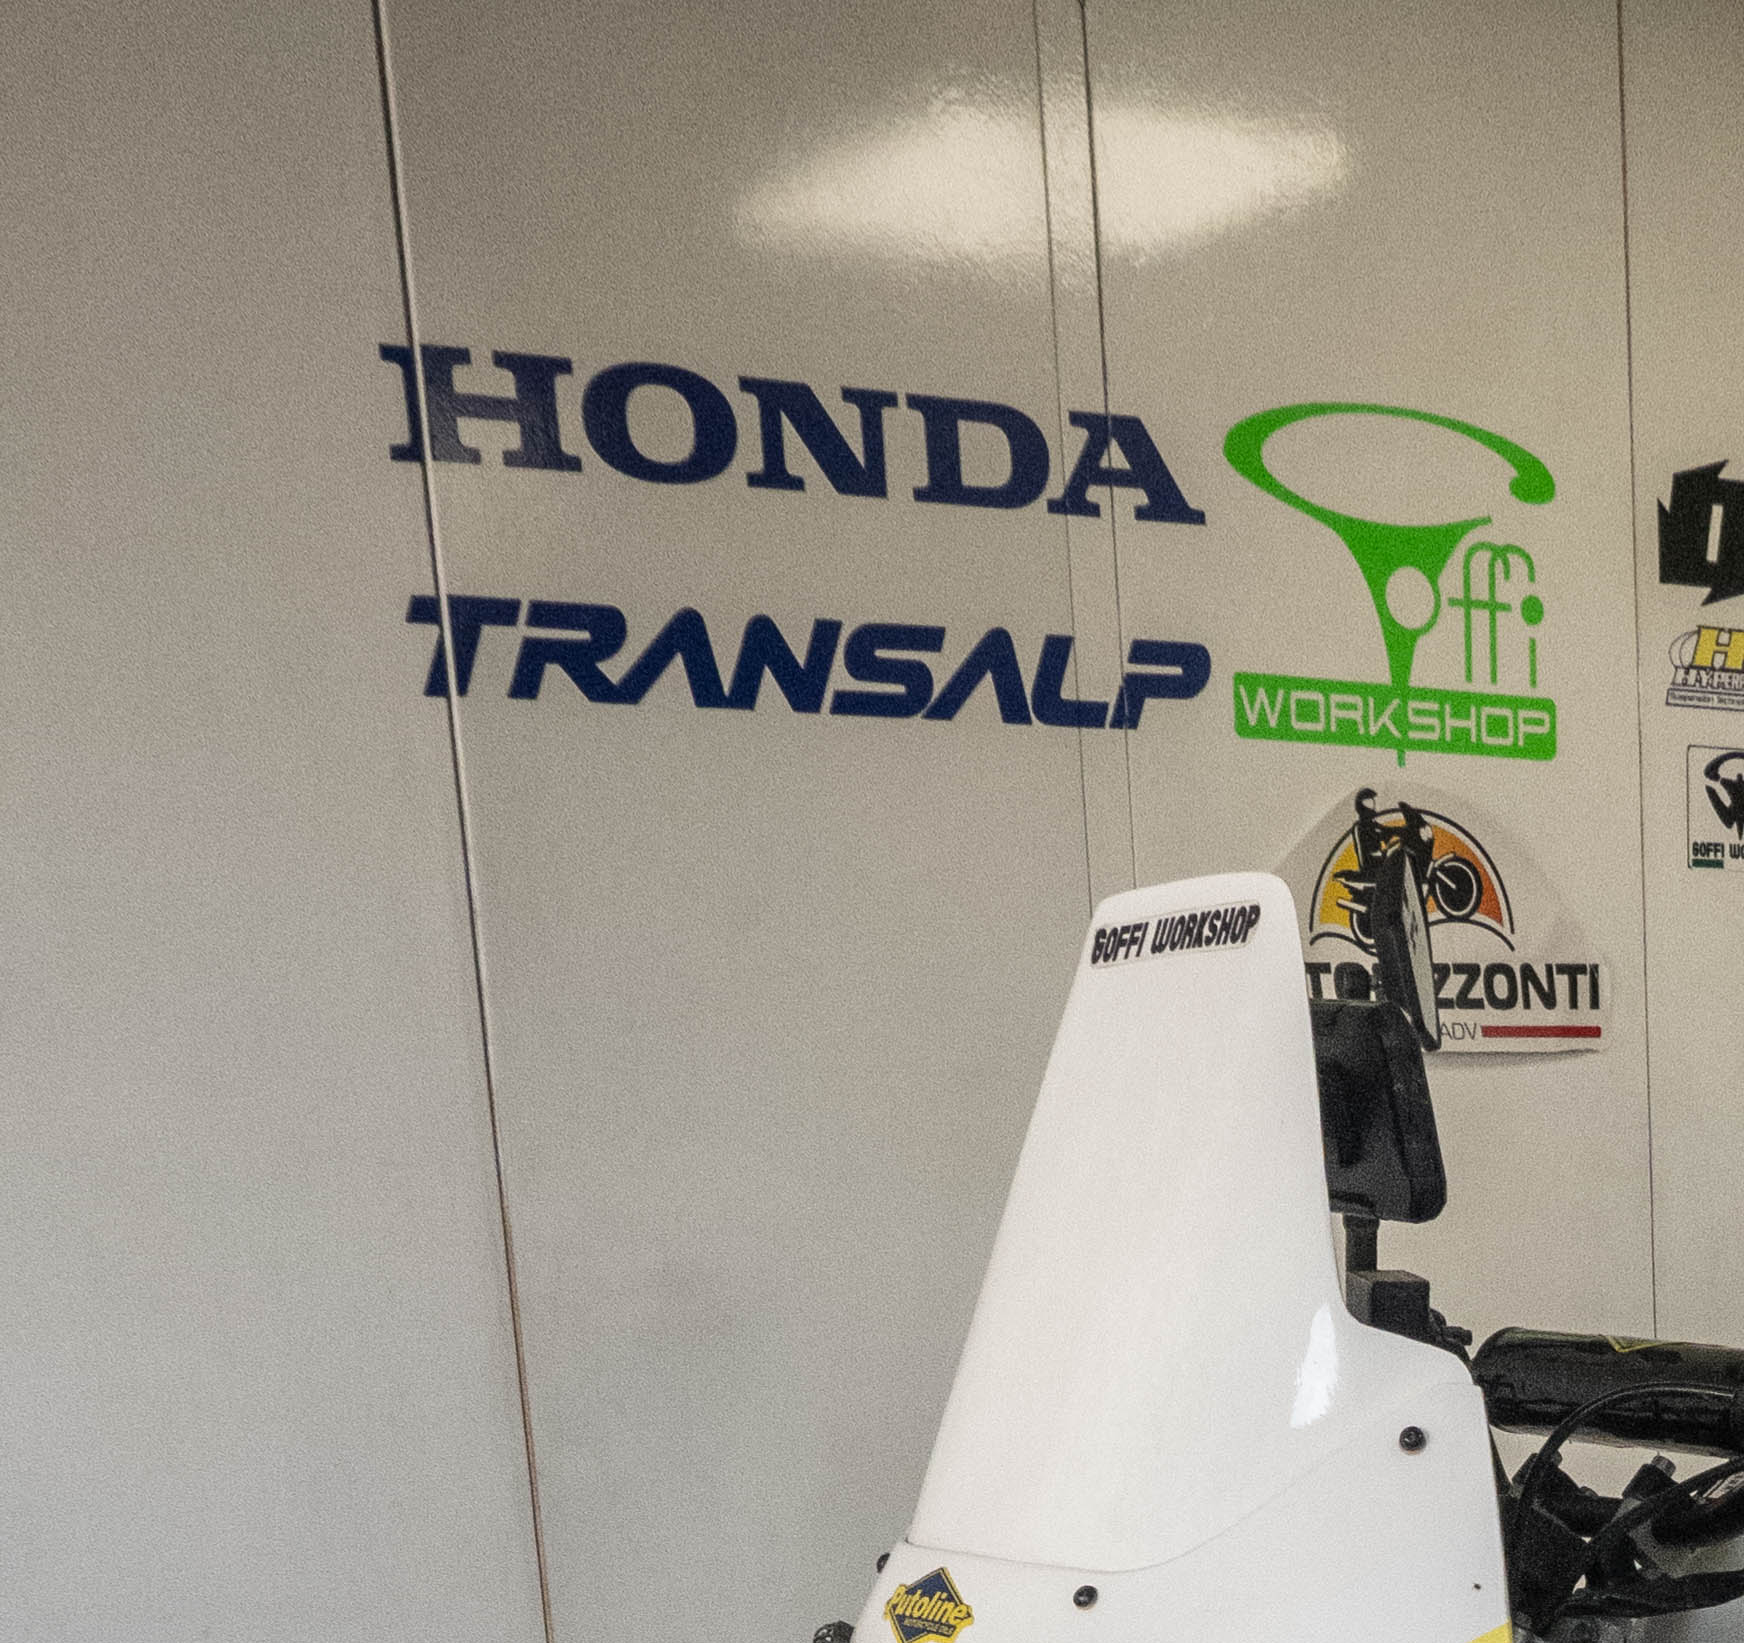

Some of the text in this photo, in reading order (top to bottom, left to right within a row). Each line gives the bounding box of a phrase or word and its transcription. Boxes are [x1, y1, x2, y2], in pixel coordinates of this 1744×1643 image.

[378, 343, 1207, 526] HONDA
[404, 593, 1212, 731] TRANSALP
[1239, 684, 1550, 747] WORKSHOP
[1692, 841, 1725, 858] GOFFI
[1090, 904, 1262, 964] GOFFI WORKSHOP
[1440, 1022, 1478, 1040] ADV
[888, 1584, 970, 1625] Putoline
